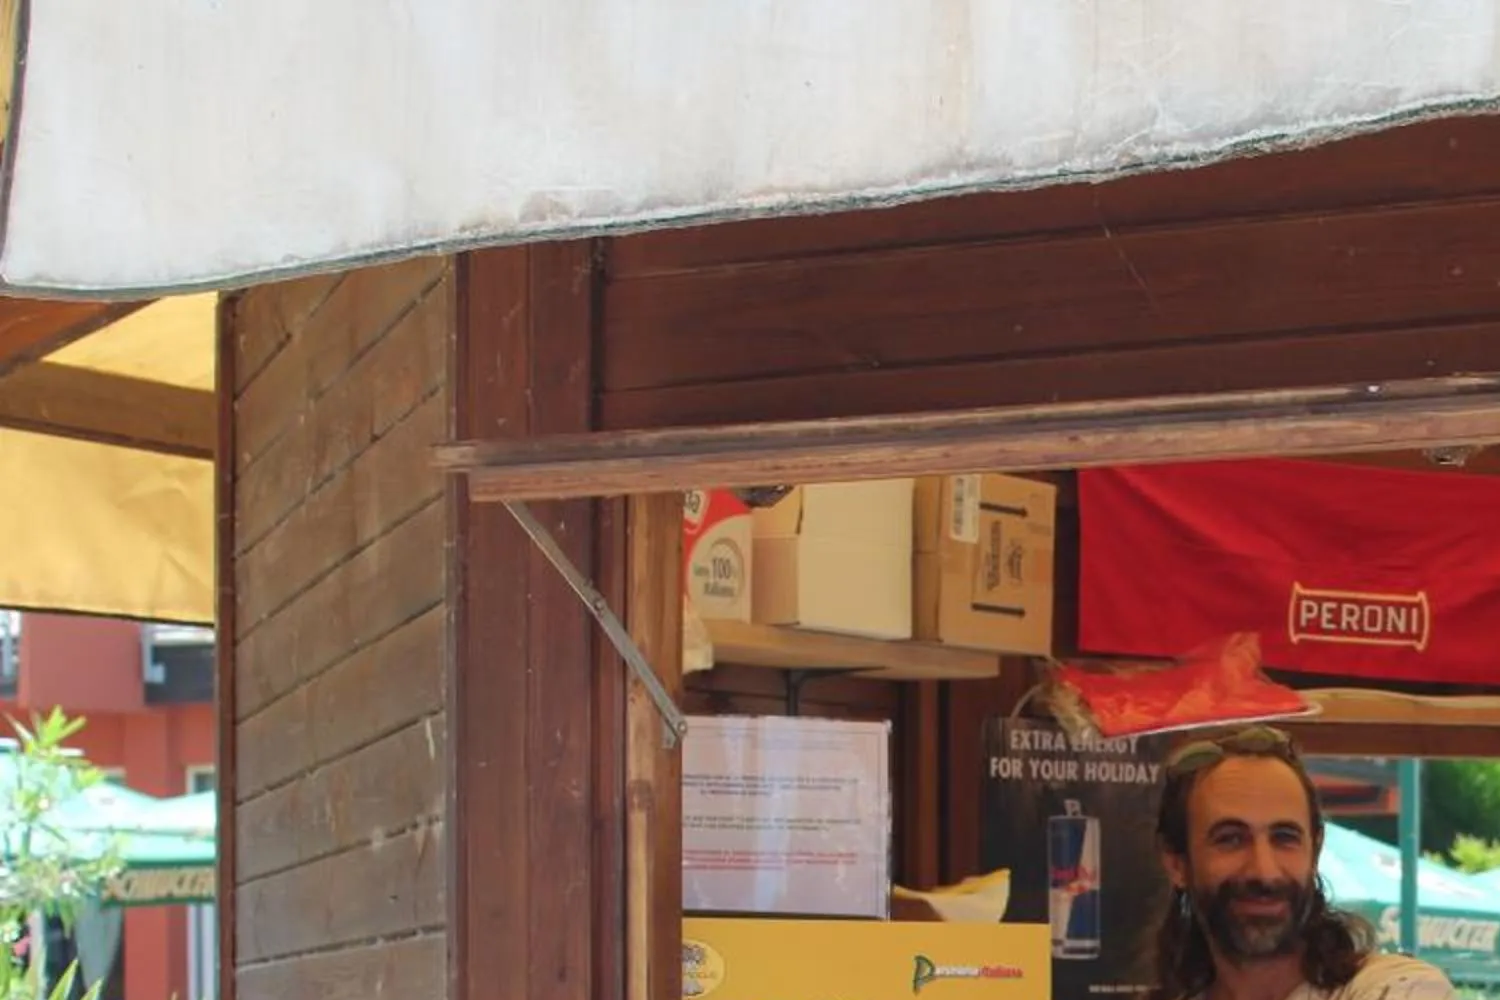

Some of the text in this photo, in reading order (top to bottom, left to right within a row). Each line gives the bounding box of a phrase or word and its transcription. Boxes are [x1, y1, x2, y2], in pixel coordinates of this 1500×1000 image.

[1300, 598, 1421, 635] PERONI
[1010, 729, 1067, 752] EXTRA
[990, 757, 1161, 785] FOR YOUR HOLIDAY
